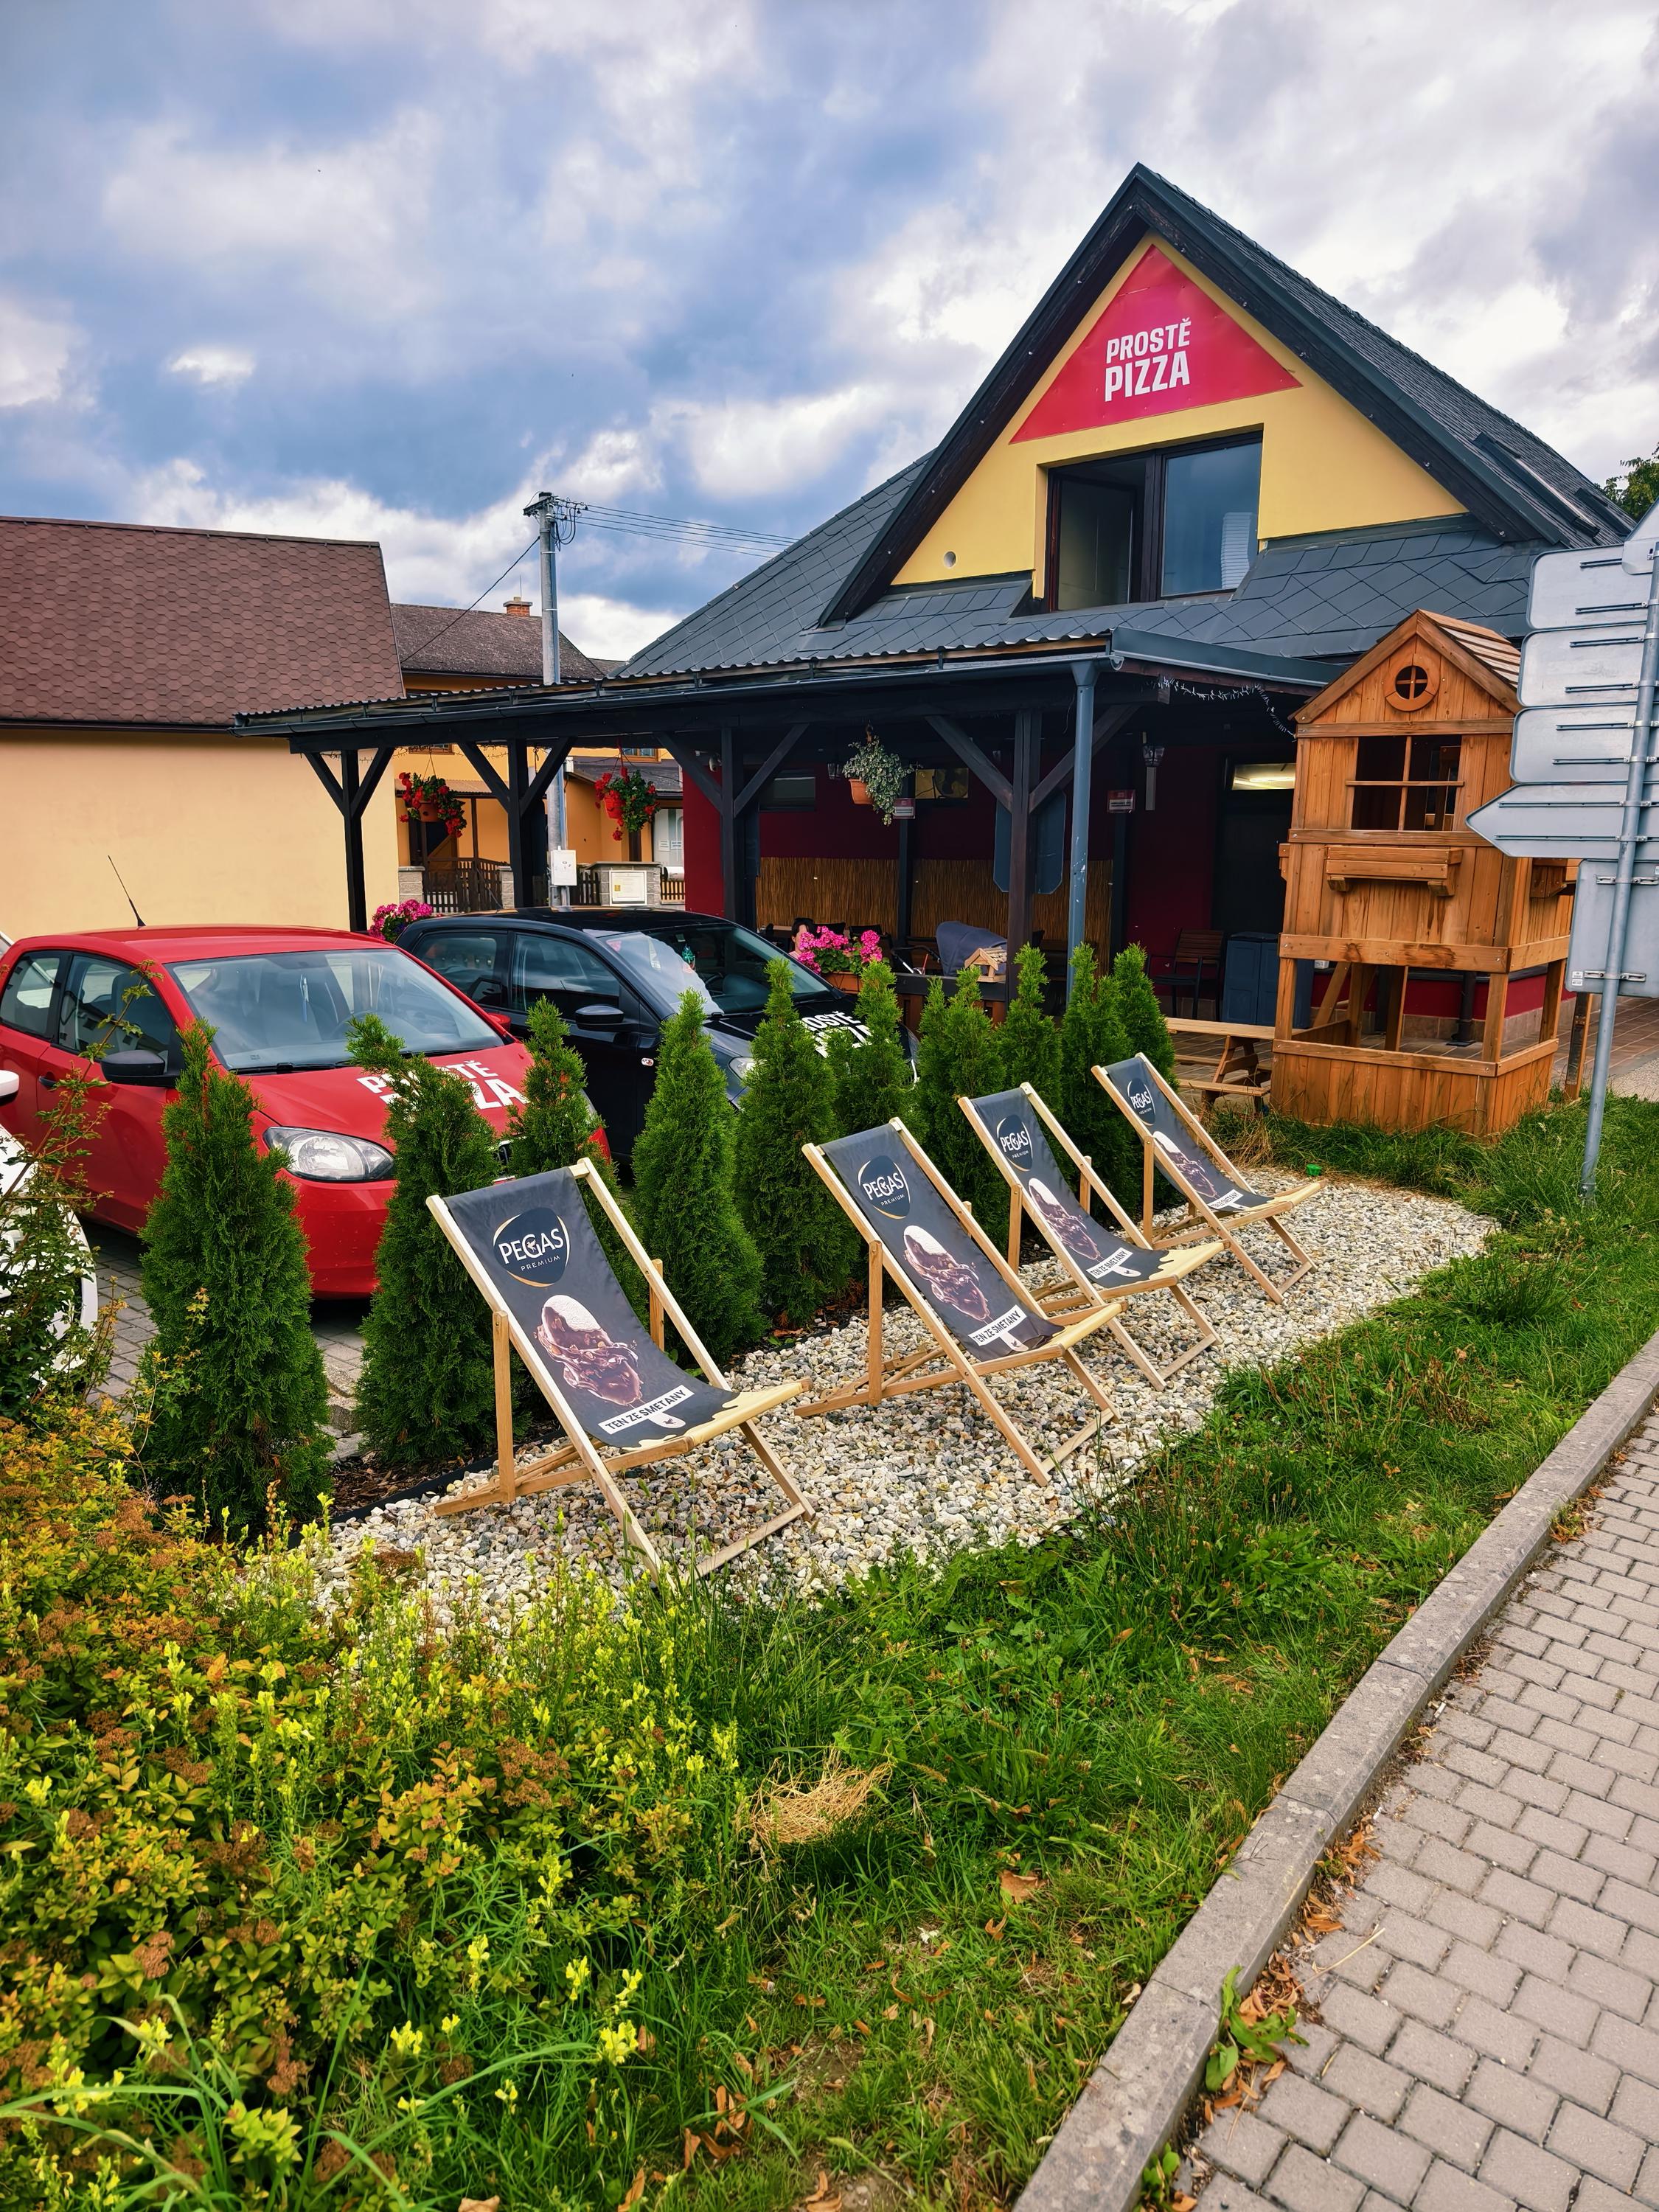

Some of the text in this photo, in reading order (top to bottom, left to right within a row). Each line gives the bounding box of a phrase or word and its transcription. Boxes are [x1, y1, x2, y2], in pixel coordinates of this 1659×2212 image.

[1106, 318, 1192, 364] PROSTĚ
[1105, 350, 1191, 402] PIZZA
[1130, 1091, 1152, 1109] PEGAS
[999, 1130, 1029, 1152] PEGAS
[862, 1172, 904, 1200] PEGAS
[880, 1194, 905, 1206] PREMIUM
[498, 1228, 564, 1265] PEGAS
[1104, 1250, 1127, 1268] SMETANY
[521, 1255, 560, 1271] PREMIUM
[973, 1310, 1020, 1343] TEN ZE SMETANY
[605, 1389, 686, 1430] TEN ZE SMETANY
